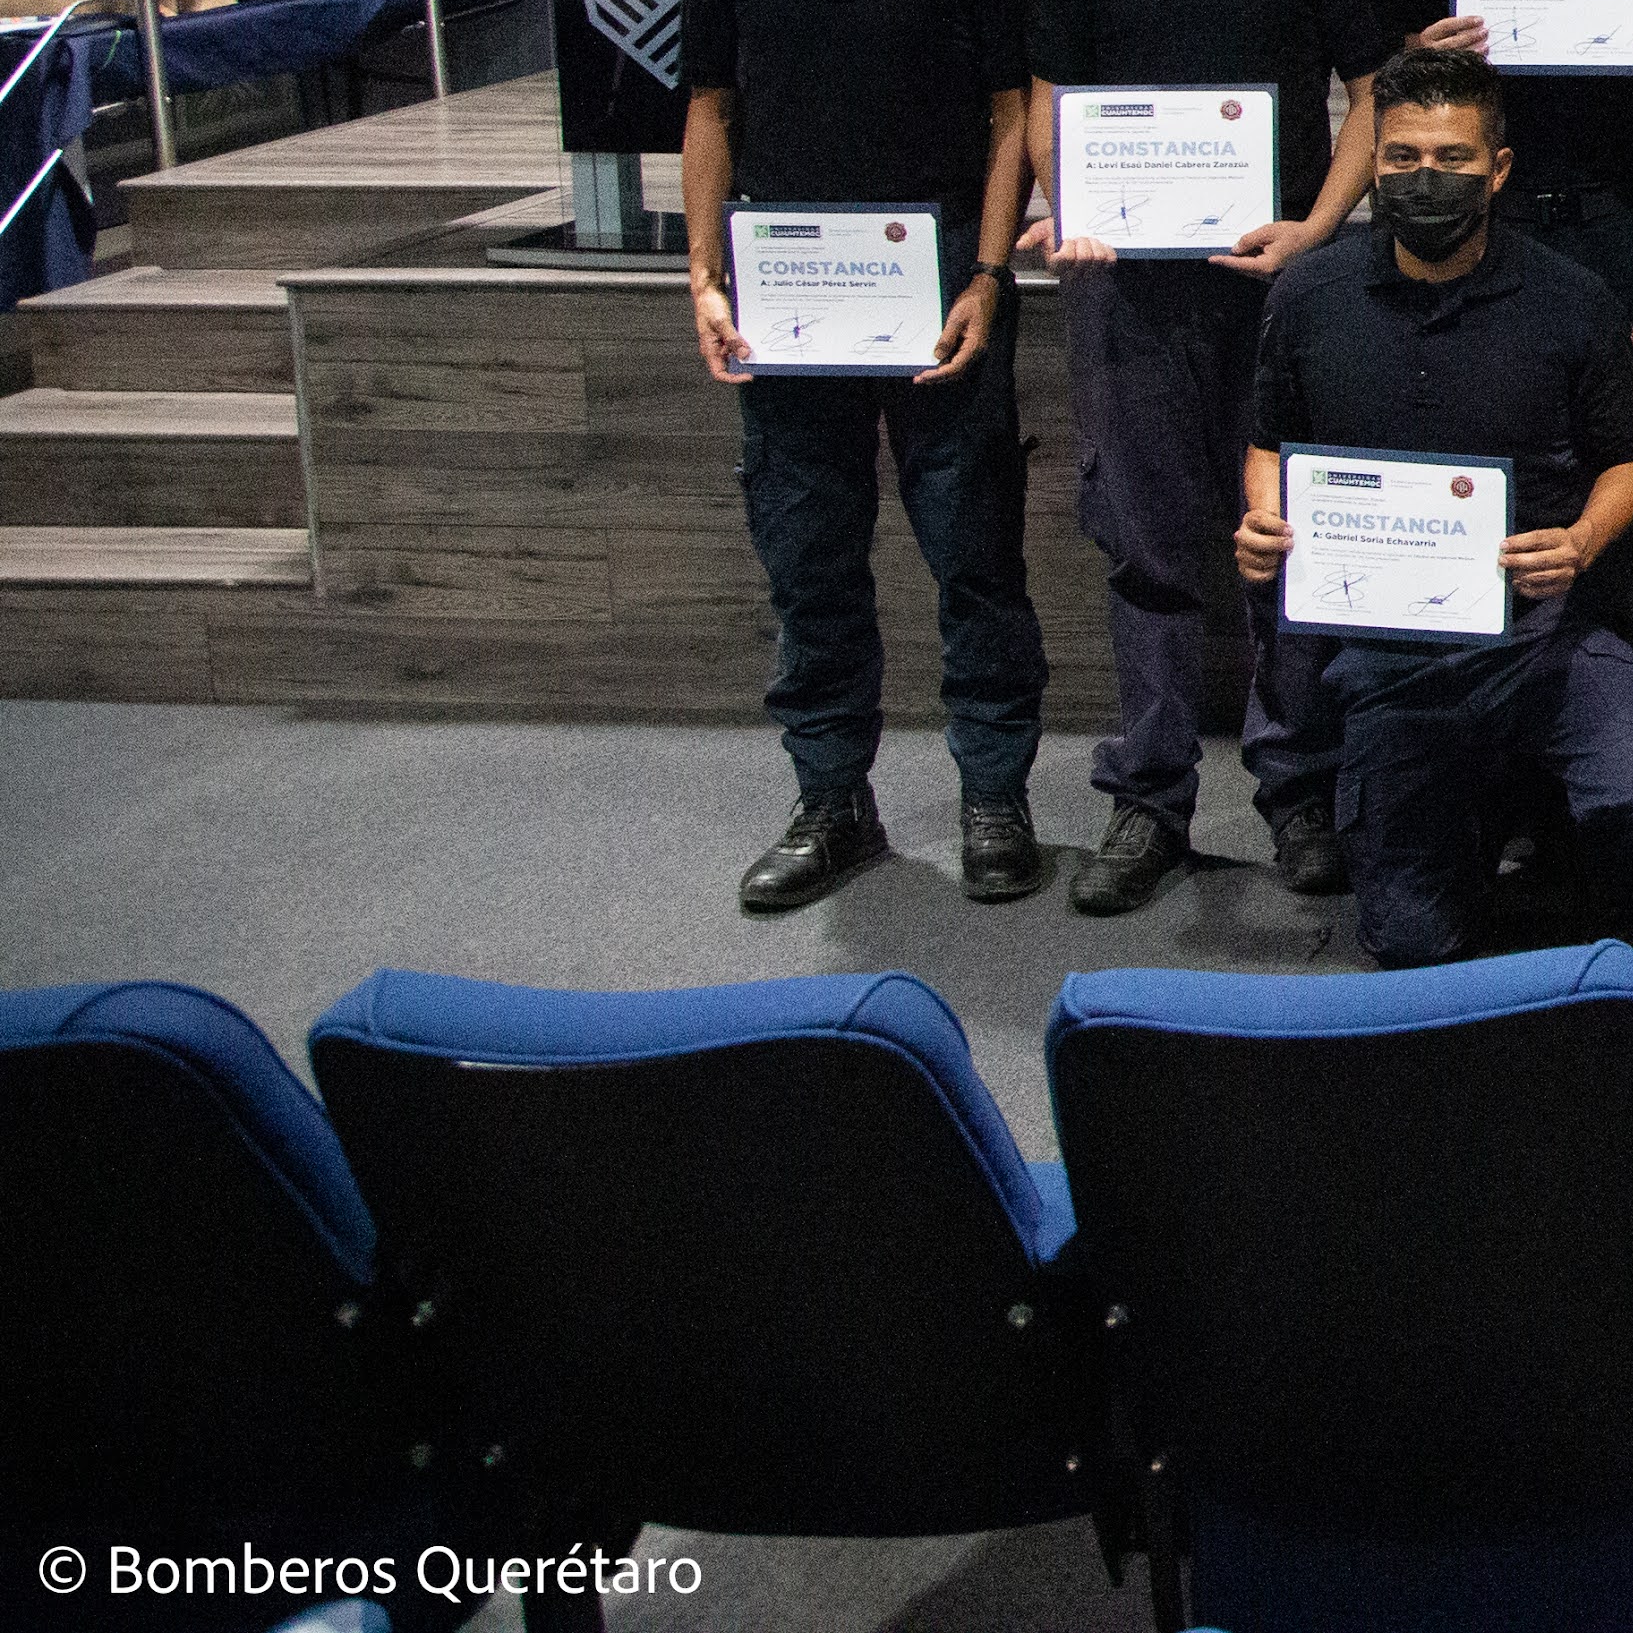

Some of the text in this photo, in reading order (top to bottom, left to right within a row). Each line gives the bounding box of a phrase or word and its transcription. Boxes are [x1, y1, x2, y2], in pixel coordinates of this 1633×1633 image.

[1085, 140, 1237, 157] CONSTANCIA
[1144, 161, 1172, 169] Daniel
[1175, 161, 1211, 169] Cabrera
[758, 260, 904, 277] CONSTANCIA
[1311, 510, 1468, 536] CONSTANCIA
[1325, 532, 1358, 542] Gabriel
[1360, 534, 1384, 544] Soria
